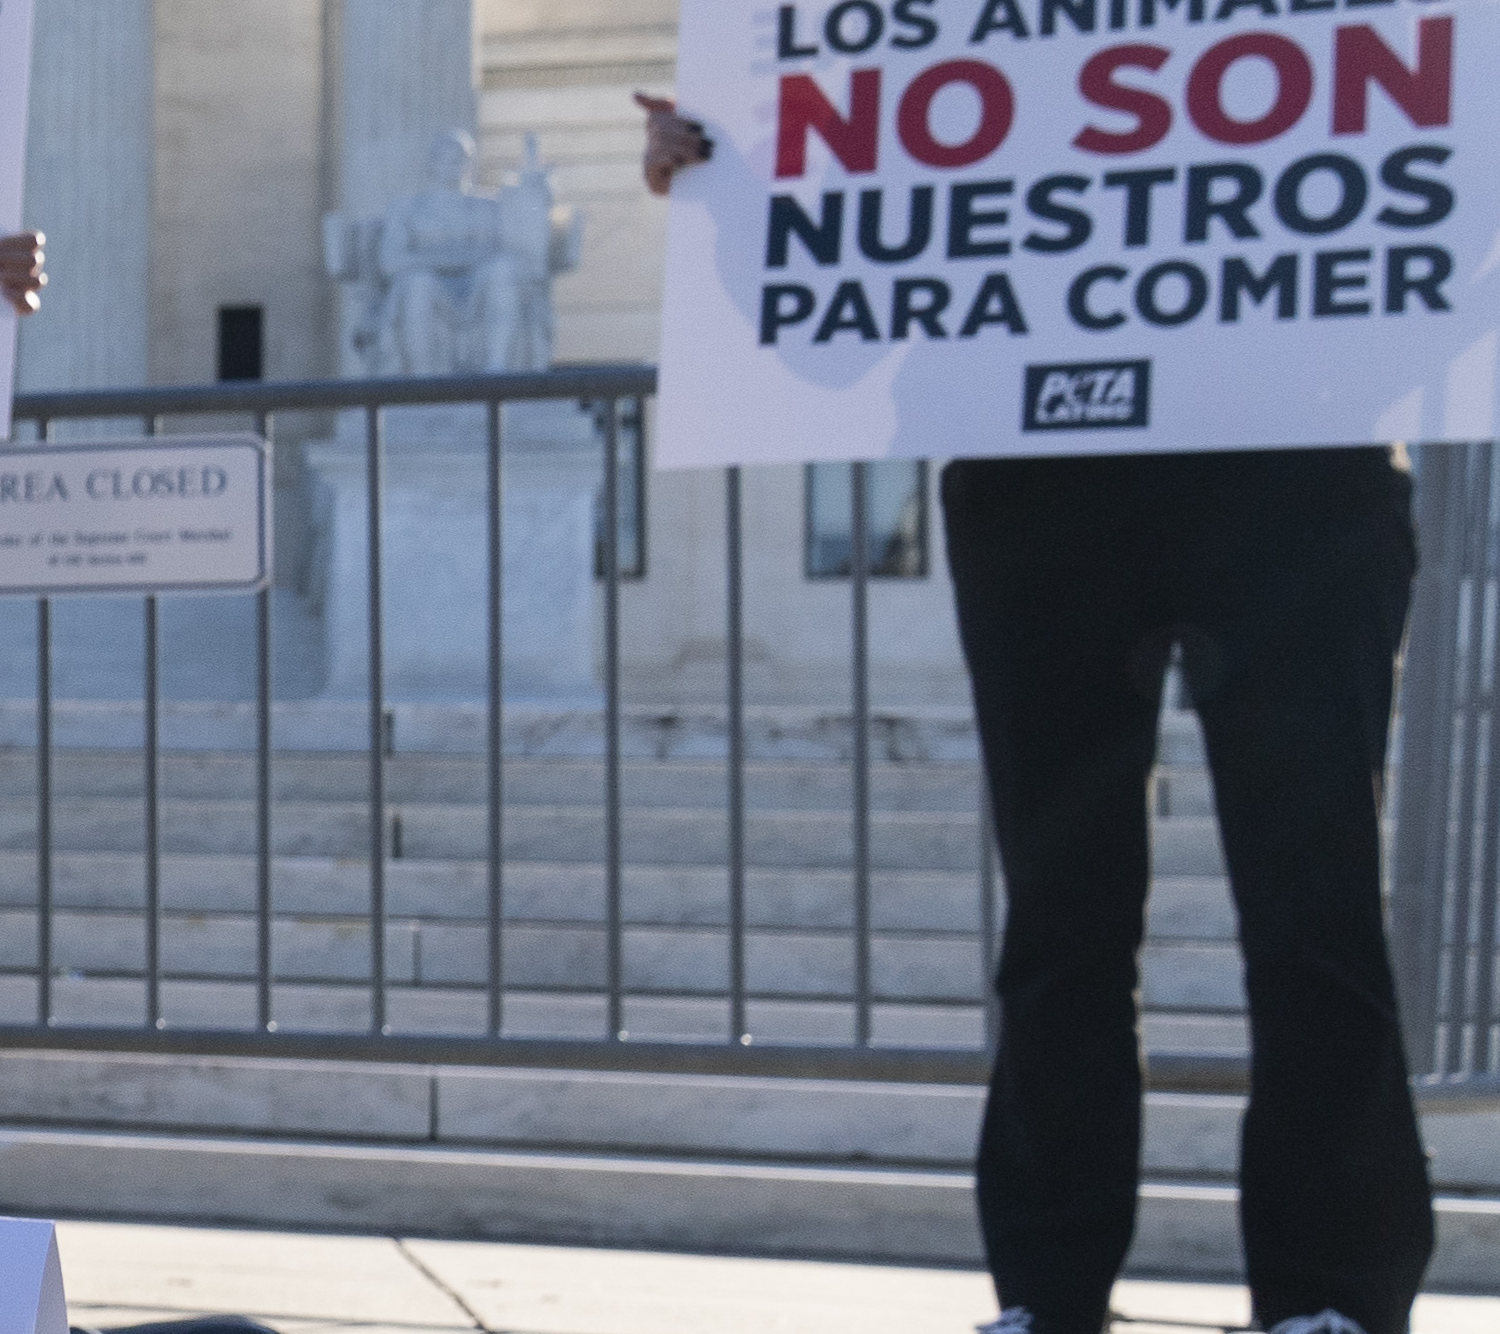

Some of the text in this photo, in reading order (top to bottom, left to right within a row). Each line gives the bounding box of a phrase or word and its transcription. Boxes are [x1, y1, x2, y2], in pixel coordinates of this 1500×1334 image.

[773, 14, 1456, 179] NO SON
[765, 144, 1456, 269] NUESTROS
[759, 245, 1455, 345] PARA COMER
[85, 467, 228, 500] CLOSED
